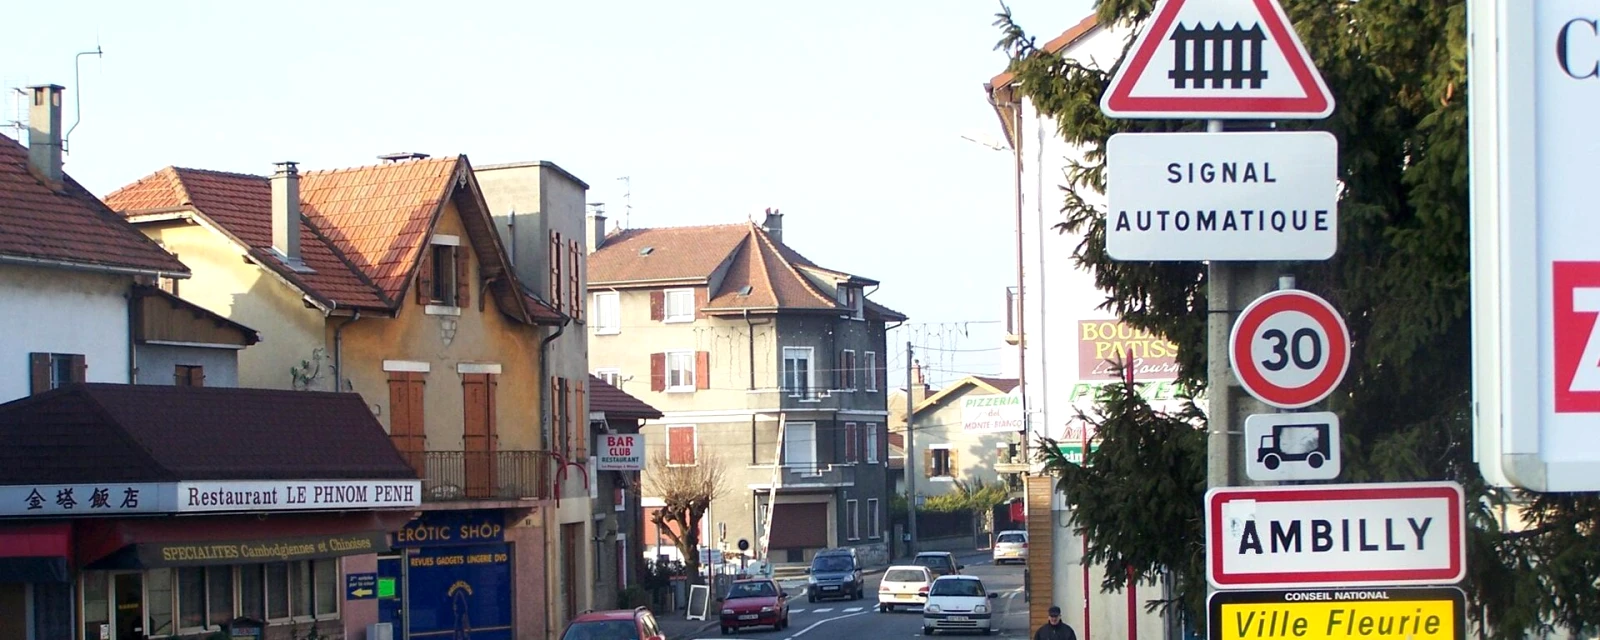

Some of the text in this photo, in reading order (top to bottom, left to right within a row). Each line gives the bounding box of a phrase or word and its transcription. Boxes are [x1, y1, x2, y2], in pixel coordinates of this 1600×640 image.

[1167, 162, 1277, 184] SIGNAL
[1115, 210, 1329, 232] AUTOMATIQUE
[1095, 340, 1179, 359] PATISS
[1261, 327, 1322, 371] 30
[965, 396, 1020, 408] PIZZERIA
[987, 408, 1000, 417] del
[607, 436, 634, 447] BAR
[609, 447, 631, 456] CLUB
[25, 487, 140, 510] 金塔飯店
[188, 485, 414, 506] Restaurant LE PHNOM PENH
[1238, 517, 1433, 554] AMBILLY
[163, 538, 371, 561] SPECIALITES Cambodgiennes et Chinoises
[410, 553, 507, 567] REVUES GADGETS LINGERIE DVD
[1284, 591, 1389, 601] CONSEIL NATIONAL
[1236, 608, 1441, 638] Ville Fleurie
